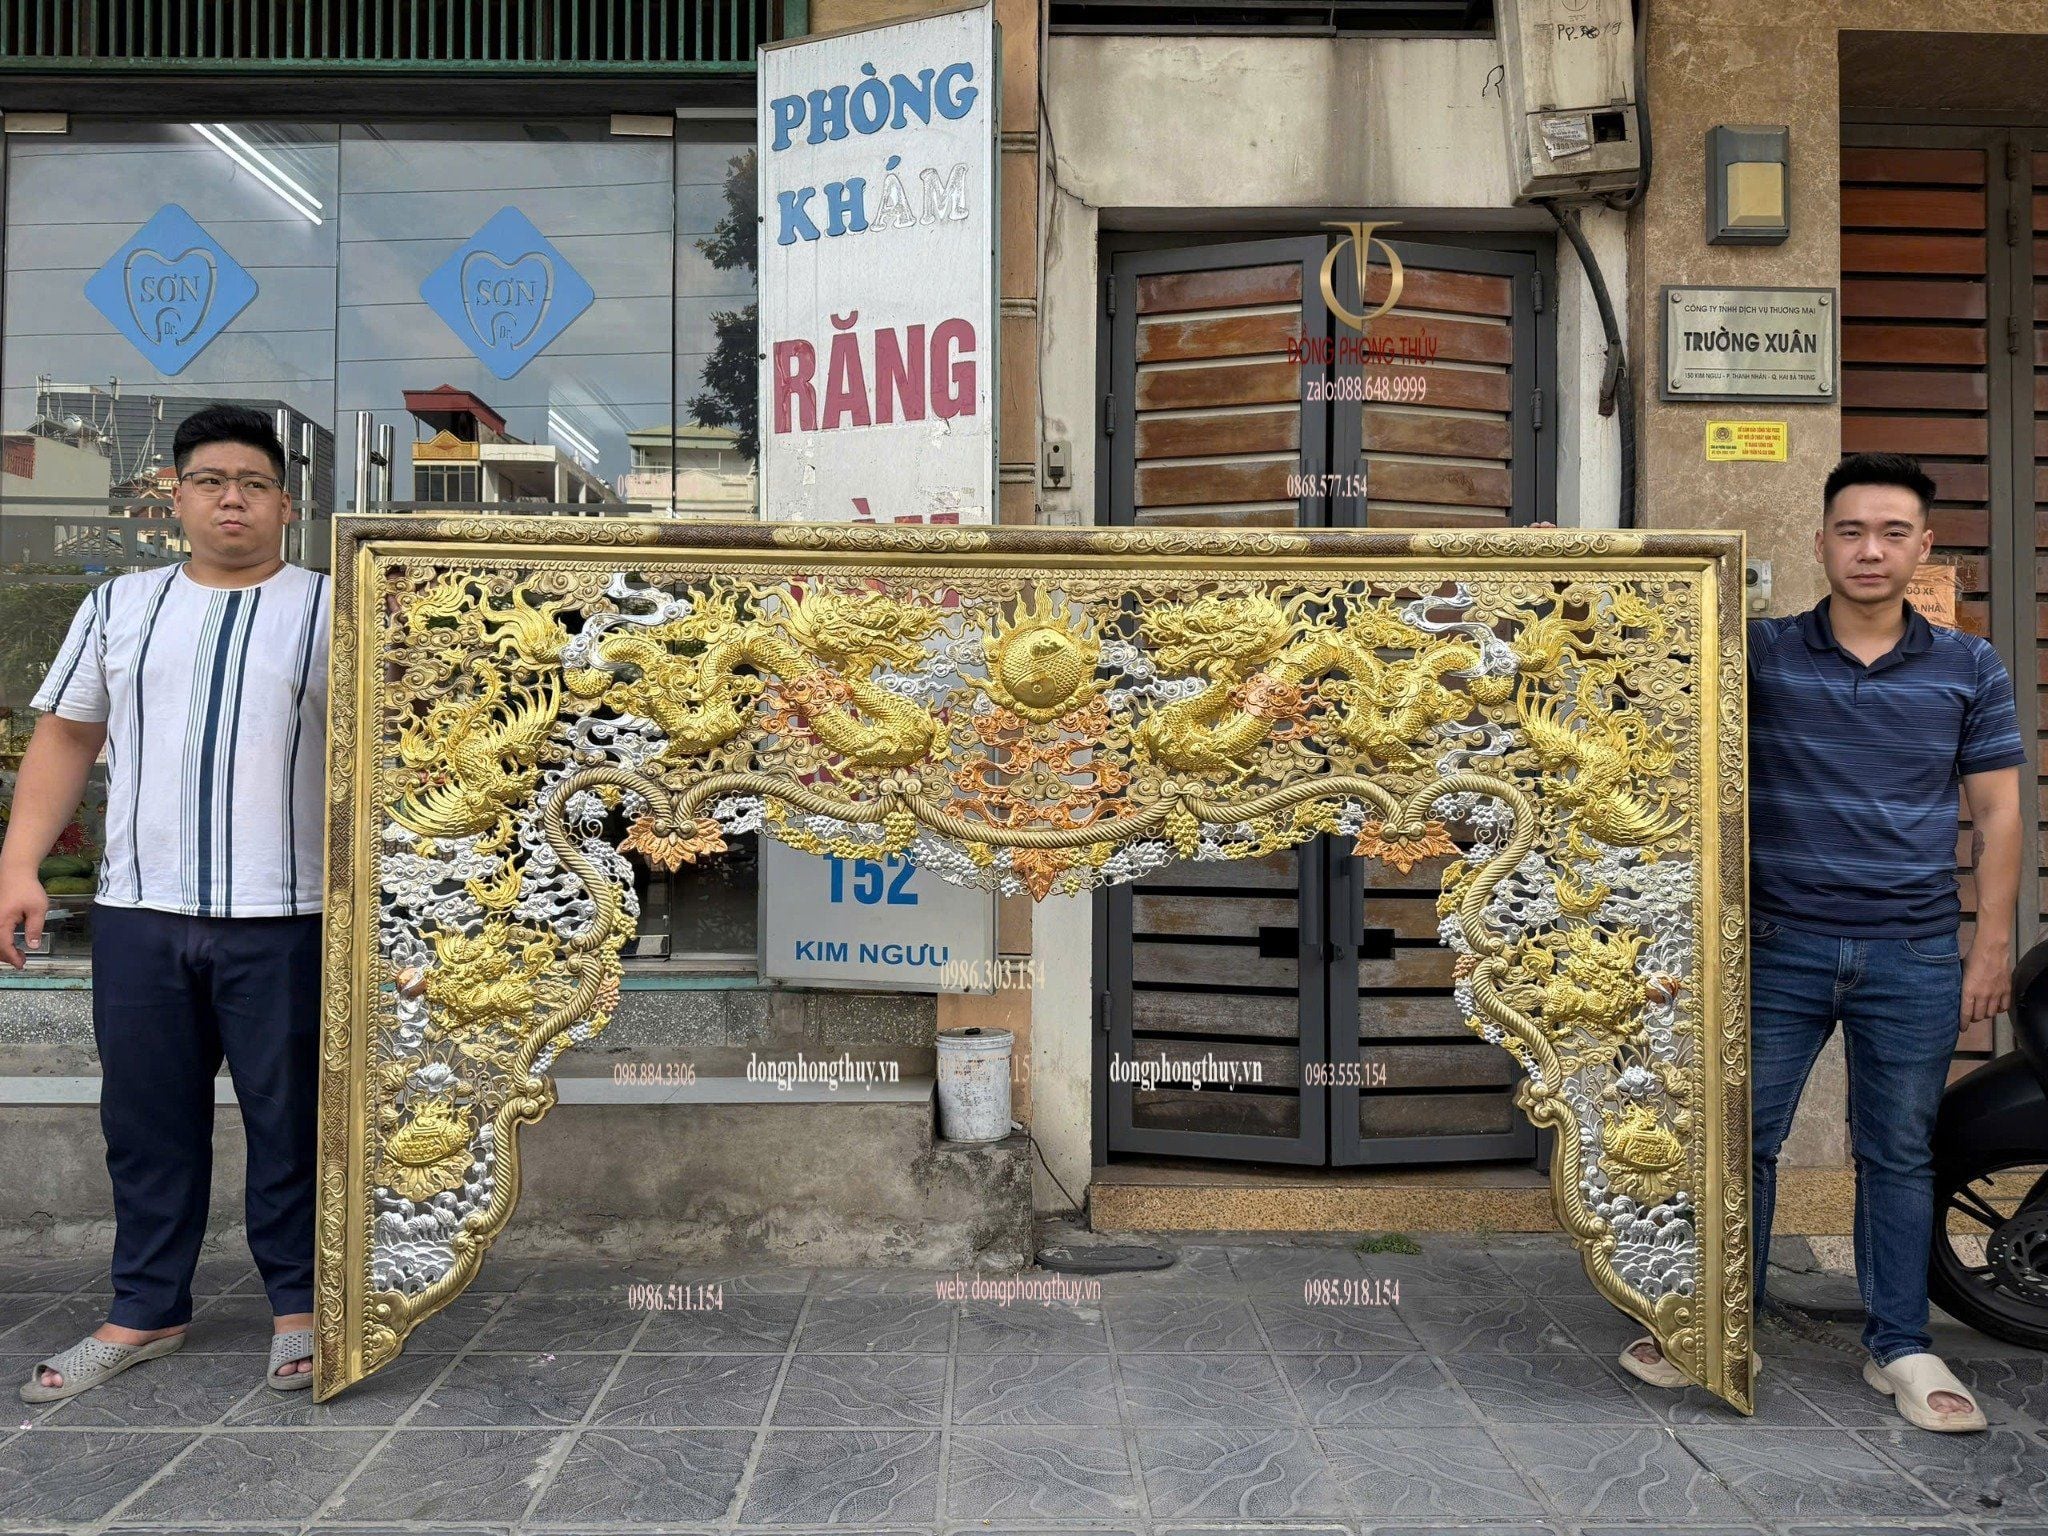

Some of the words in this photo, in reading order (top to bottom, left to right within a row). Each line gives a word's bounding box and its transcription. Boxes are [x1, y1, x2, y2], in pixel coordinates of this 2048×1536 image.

[770, 62, 979, 151] PHÒNG
[777, 155, 970, 246] KHÁM
[141, 273, 200, 303] SƠN
[476, 277, 537, 306] SƠN
[1684, 304, 1708, 313] CÔNG
[1738, 306, 1757, 315] DỊCH
[1758, 307, 1768, 315] VỤ
[1801, 307, 1816, 316] MẠI
[164, 321, 178, 335] Dr.
[1684, 326, 1760, 353] TRƯỜNG
[1764, 329, 1817, 353] XUÂN
[773, 310, 976, 434] RĂNG
[823, 847, 918, 905] 152
[795, 941, 848, 962] KIM
[859, 943, 949, 967] NGƯU
